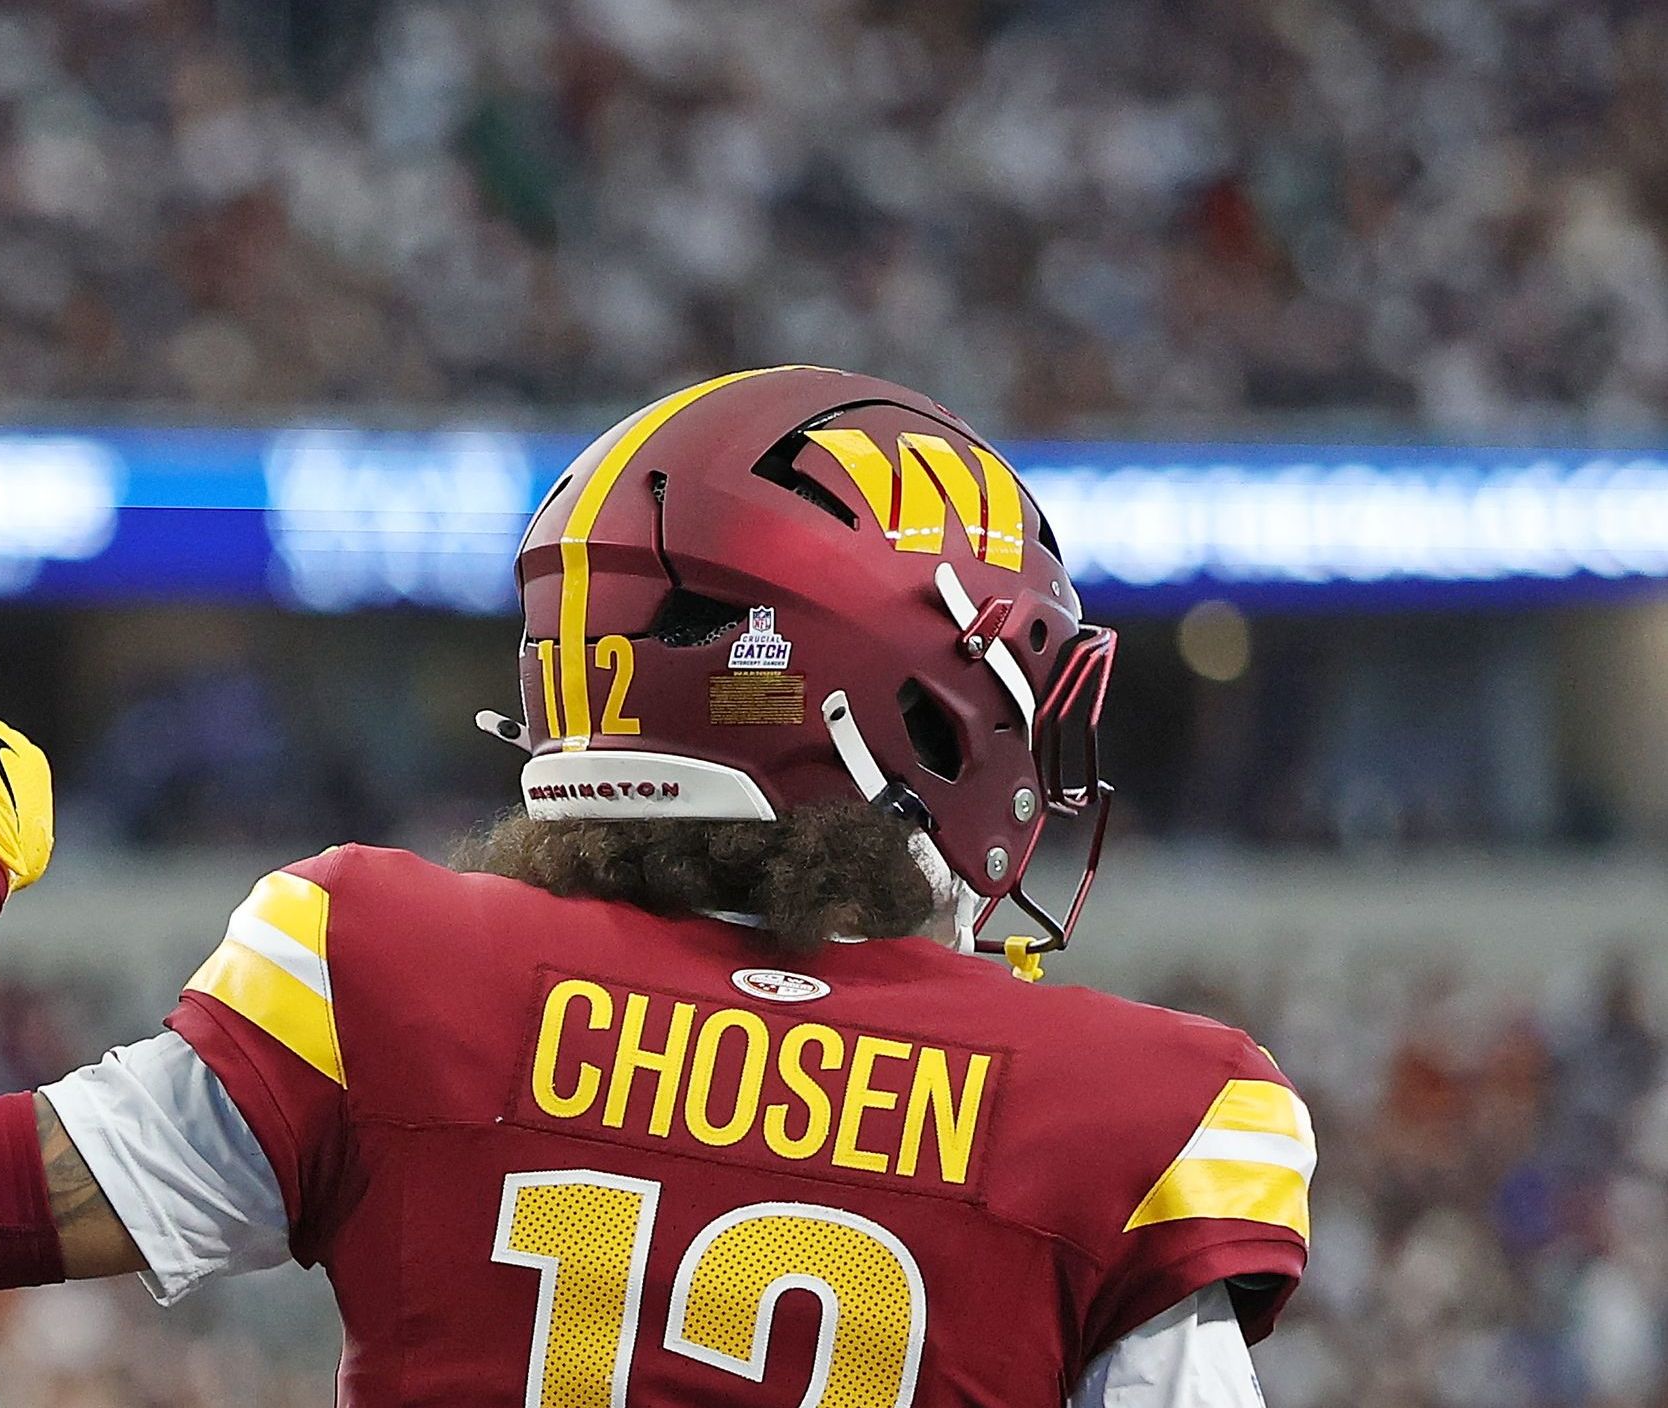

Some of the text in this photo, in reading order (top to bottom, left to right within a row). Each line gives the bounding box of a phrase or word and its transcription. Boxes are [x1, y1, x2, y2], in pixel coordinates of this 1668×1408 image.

[733, 643, 789, 660] CATCH
[742, 635, 781, 644] CRUCIAL
[538, 634, 641, 740] 12
[530, 977, 992, 1186] CHOSEN
